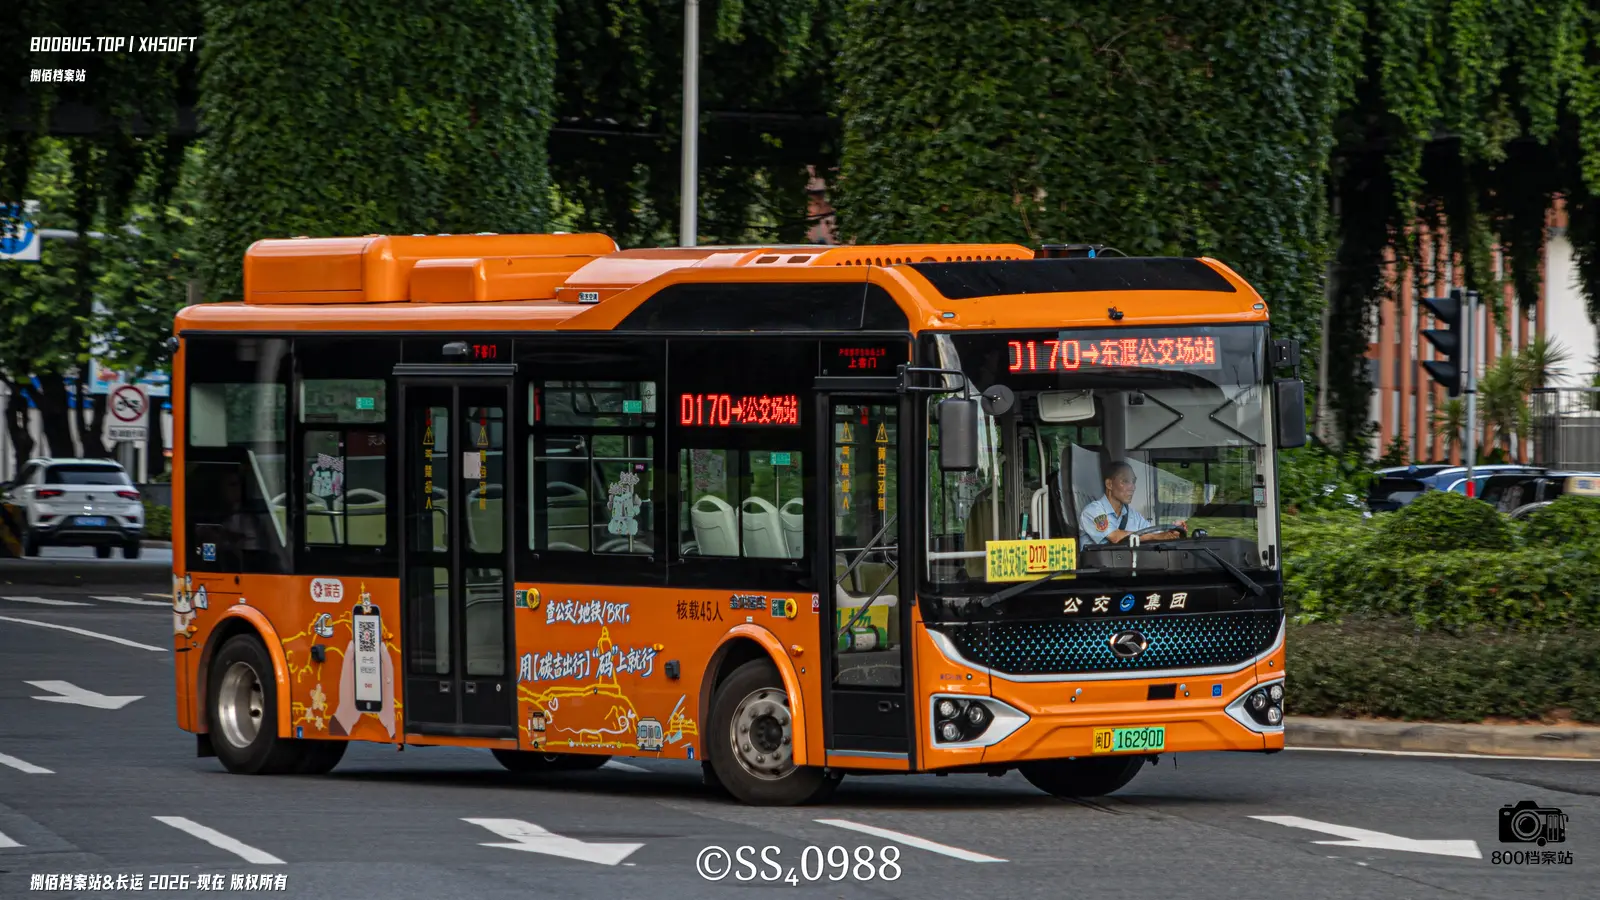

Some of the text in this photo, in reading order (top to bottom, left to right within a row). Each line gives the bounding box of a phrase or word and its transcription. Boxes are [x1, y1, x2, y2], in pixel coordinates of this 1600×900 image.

[1100, 337, 1215, 366] 东渡公交场站
[681, 394, 731, 425] D170
[1029, 544, 1048, 564] D170
[676, 600, 724, 622] 核载45人
